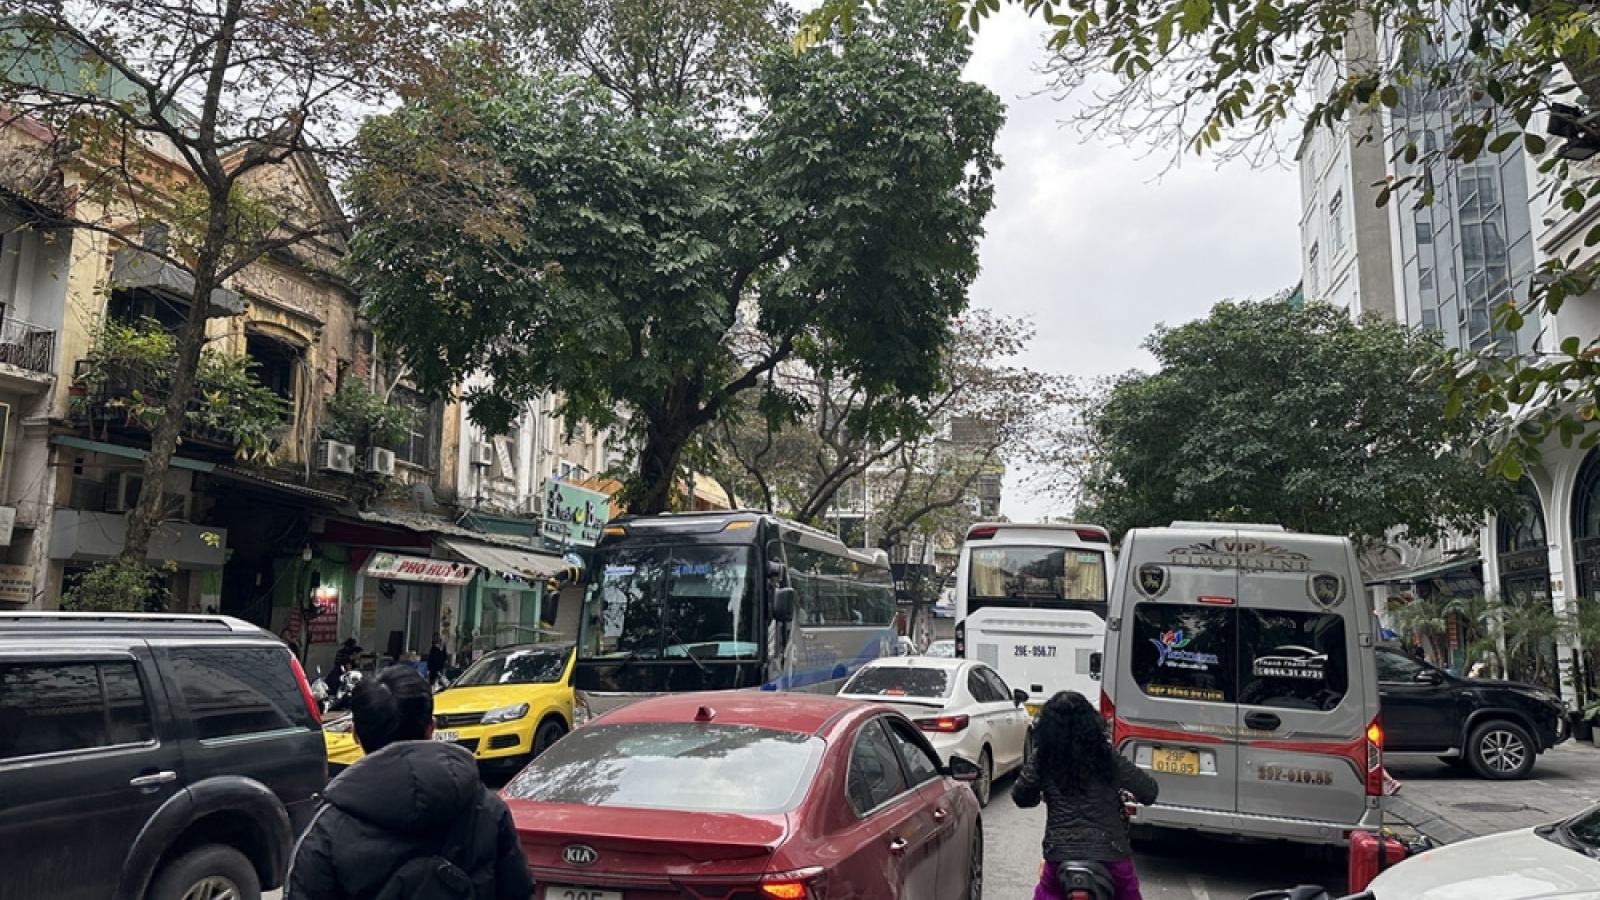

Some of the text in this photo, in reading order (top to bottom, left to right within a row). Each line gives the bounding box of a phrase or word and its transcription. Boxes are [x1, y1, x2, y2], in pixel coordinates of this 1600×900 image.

[1224, 542, 1256, 552] VIP
[427, 563, 453, 577] HUY
[1171, 555, 1311, 571] LIMOUSINE
[567, 848, 591, 862] KIA
